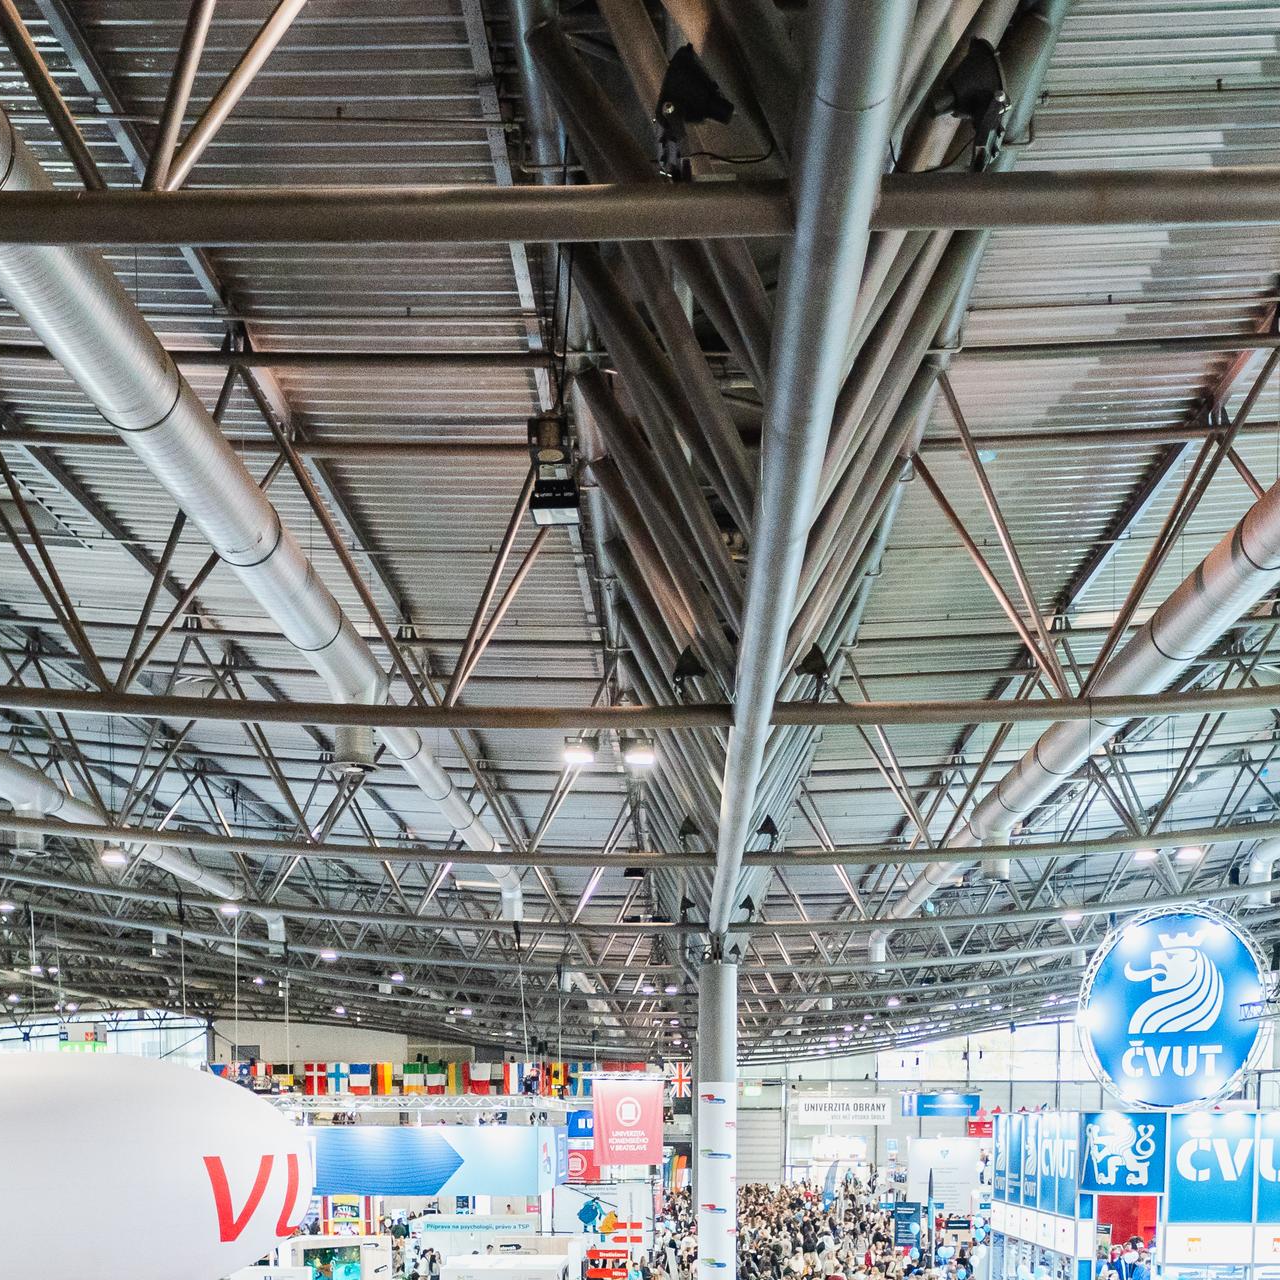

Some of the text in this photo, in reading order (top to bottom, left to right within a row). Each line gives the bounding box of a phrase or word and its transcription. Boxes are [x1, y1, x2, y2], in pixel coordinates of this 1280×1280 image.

[1121, 1040, 1222, 1078] ČVUT
[804, 1103, 886, 1112] UNIVERZITA OBRANY
